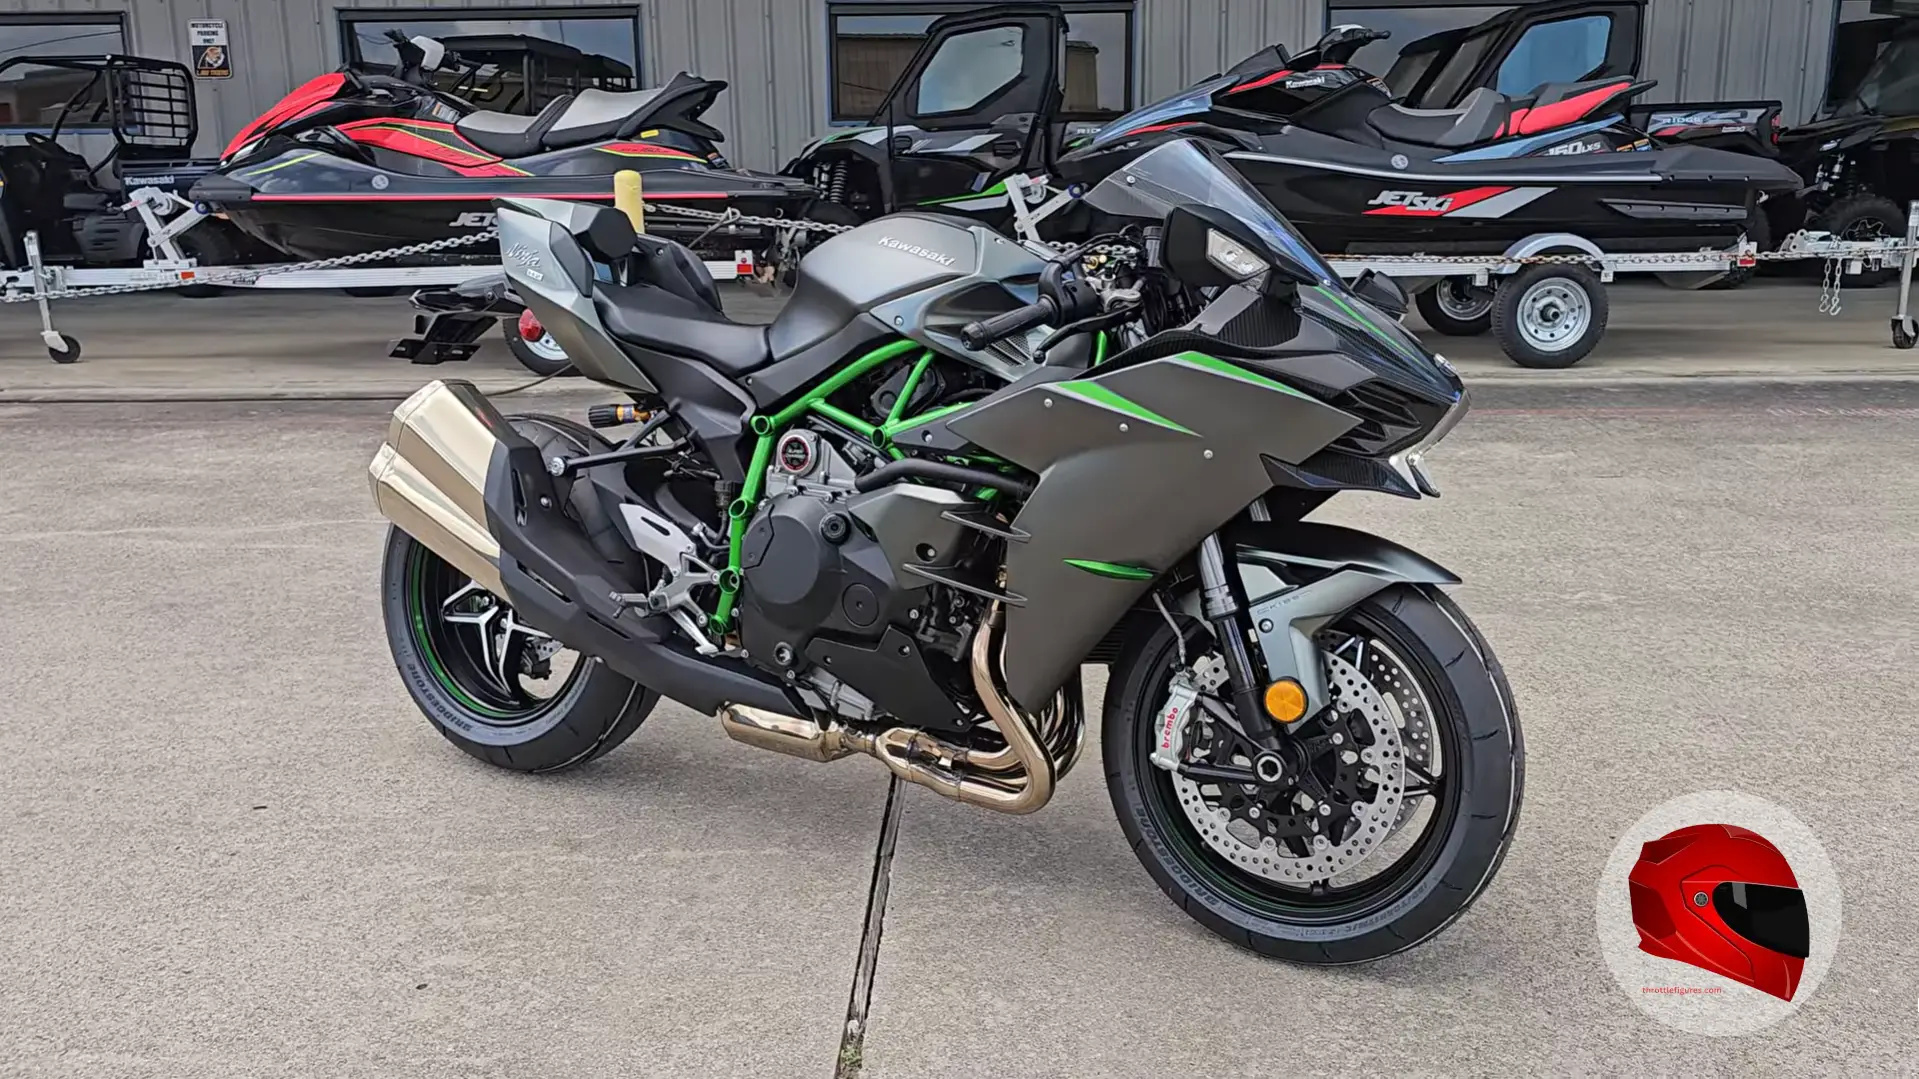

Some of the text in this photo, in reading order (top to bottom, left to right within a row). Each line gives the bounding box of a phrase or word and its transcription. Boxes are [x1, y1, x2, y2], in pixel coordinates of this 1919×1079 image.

[1285, 77, 1325, 89] Kawasaki
[124, 175, 175, 186] Kawasaki
[505, 242, 541, 269] Ninja
[878, 236, 956, 267] Kawasaki
[1161, 707, 1179, 749] brembo
